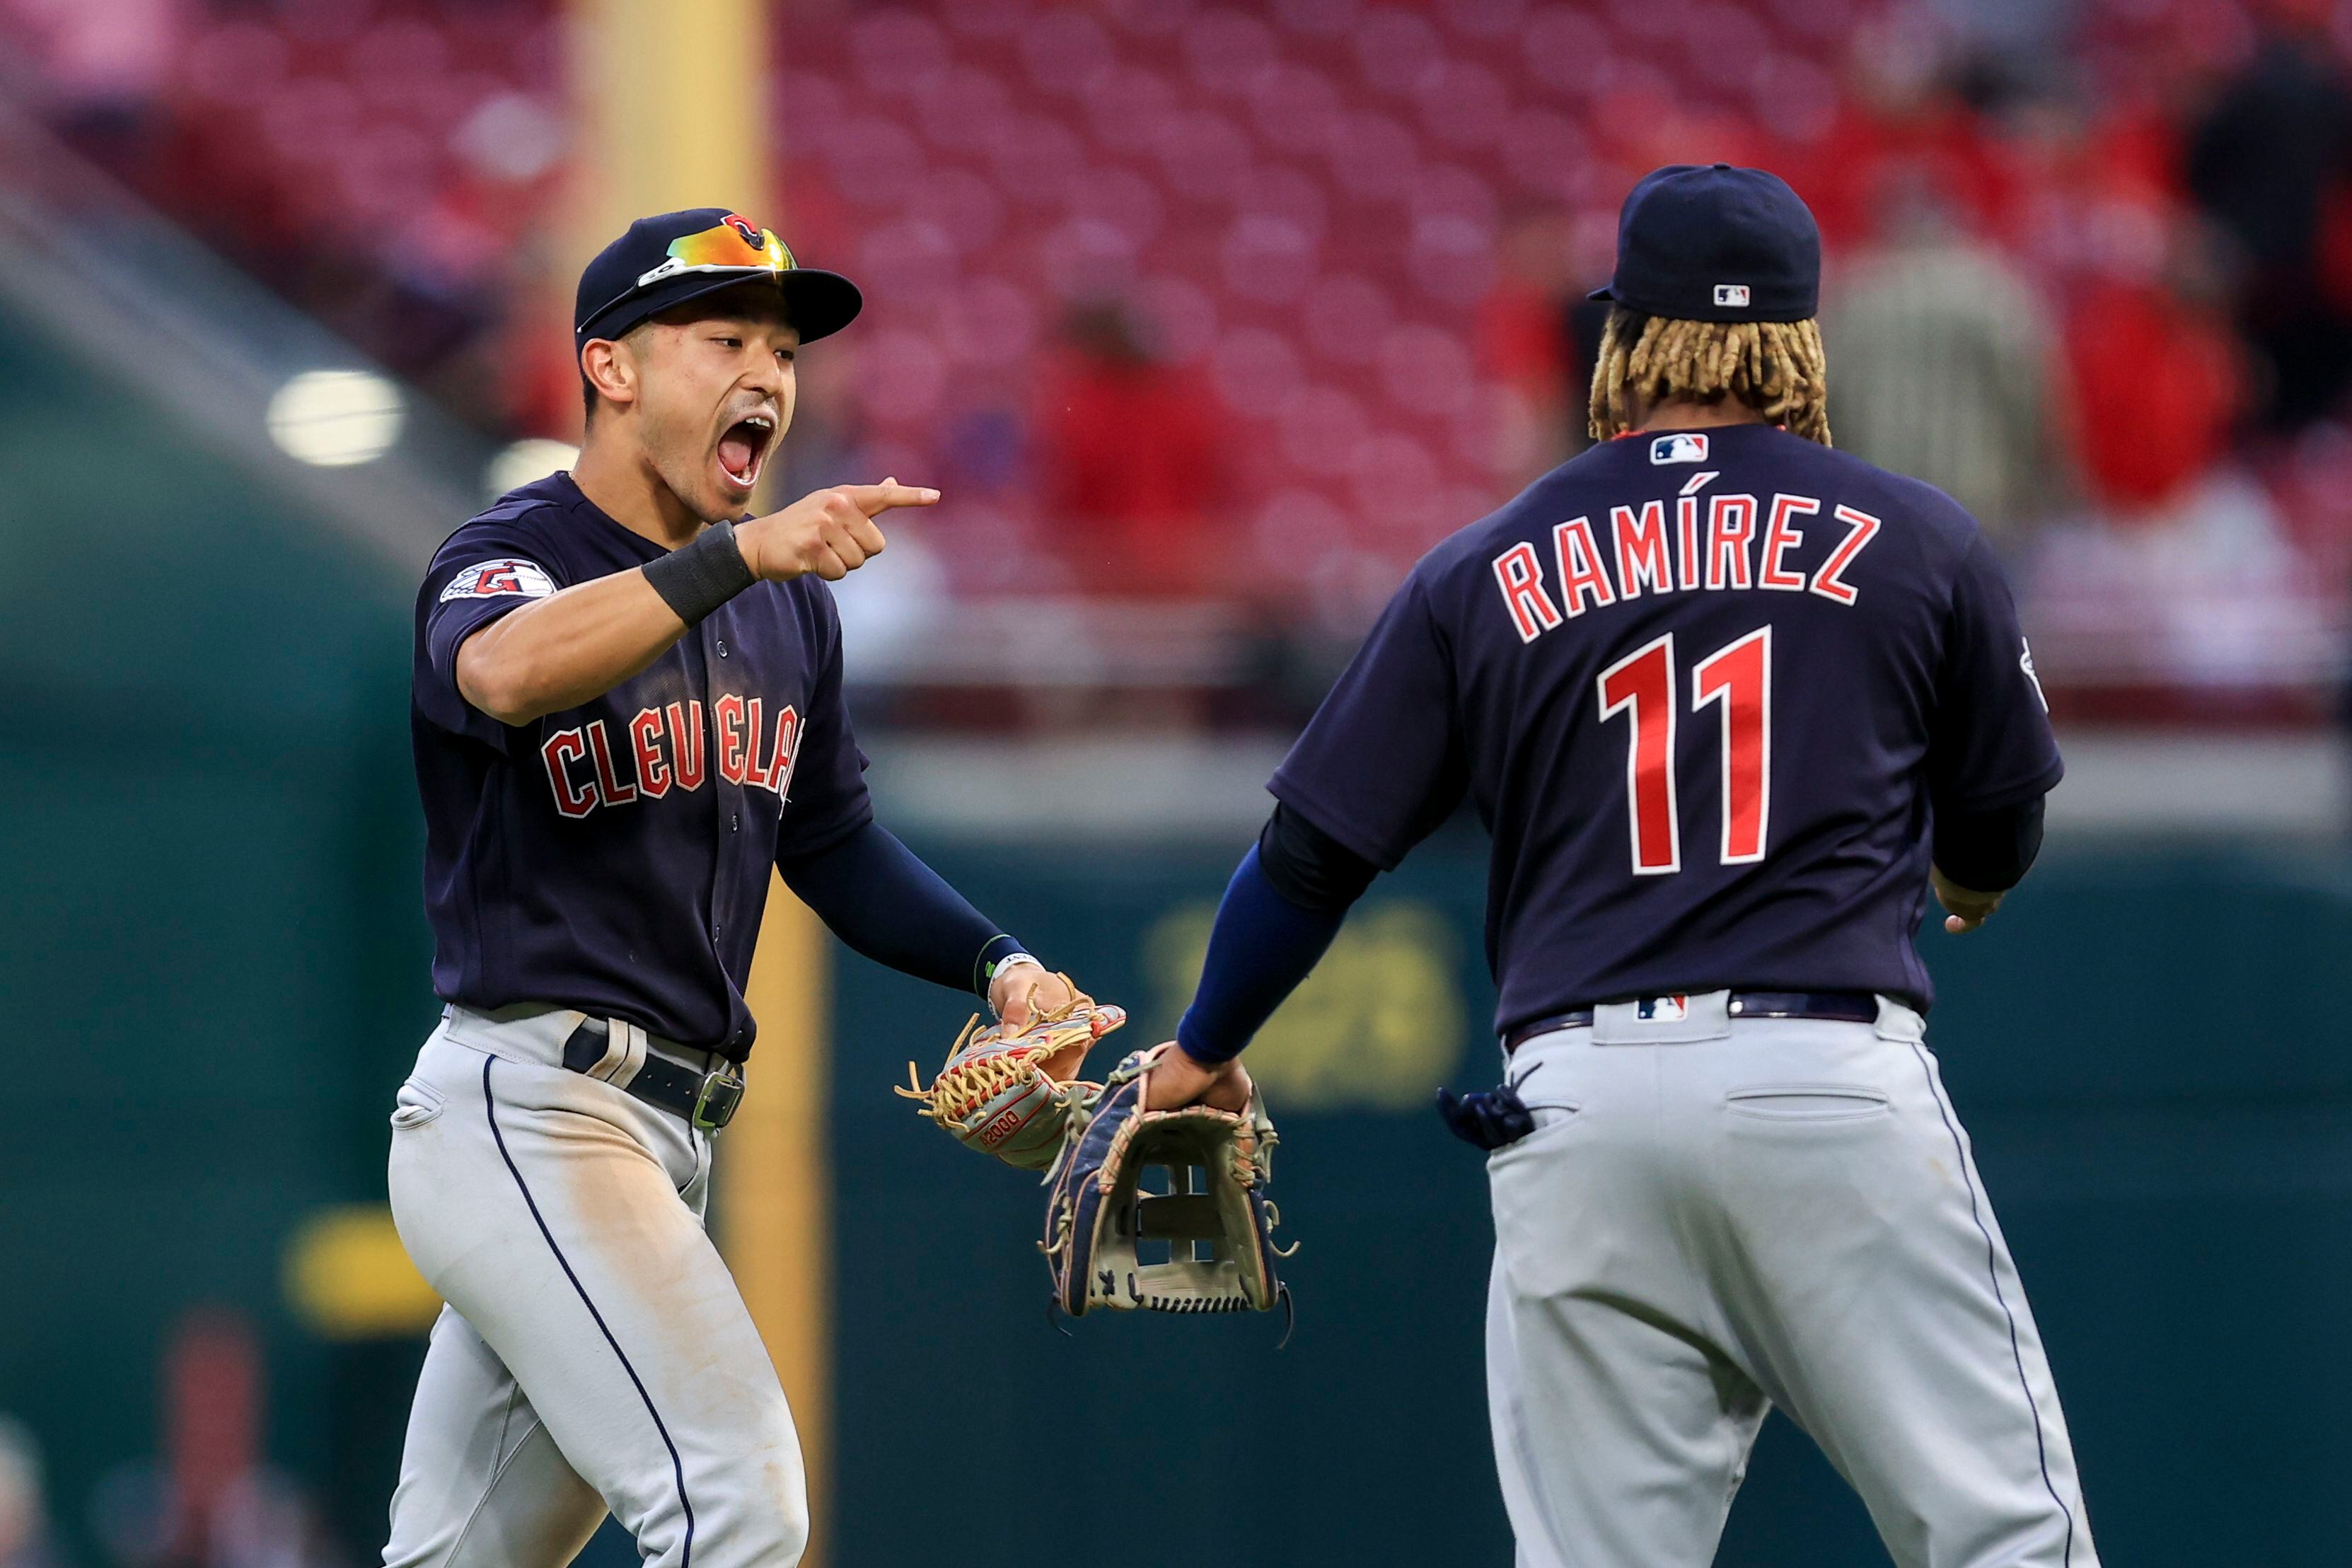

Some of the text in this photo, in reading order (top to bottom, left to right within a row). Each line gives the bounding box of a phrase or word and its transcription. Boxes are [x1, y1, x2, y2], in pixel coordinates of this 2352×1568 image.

[1492, 470, 1882, 644] RAMÍREZ
[540, 692, 806, 820] CLEVELA
[1597, 623, 1772, 876] 11
